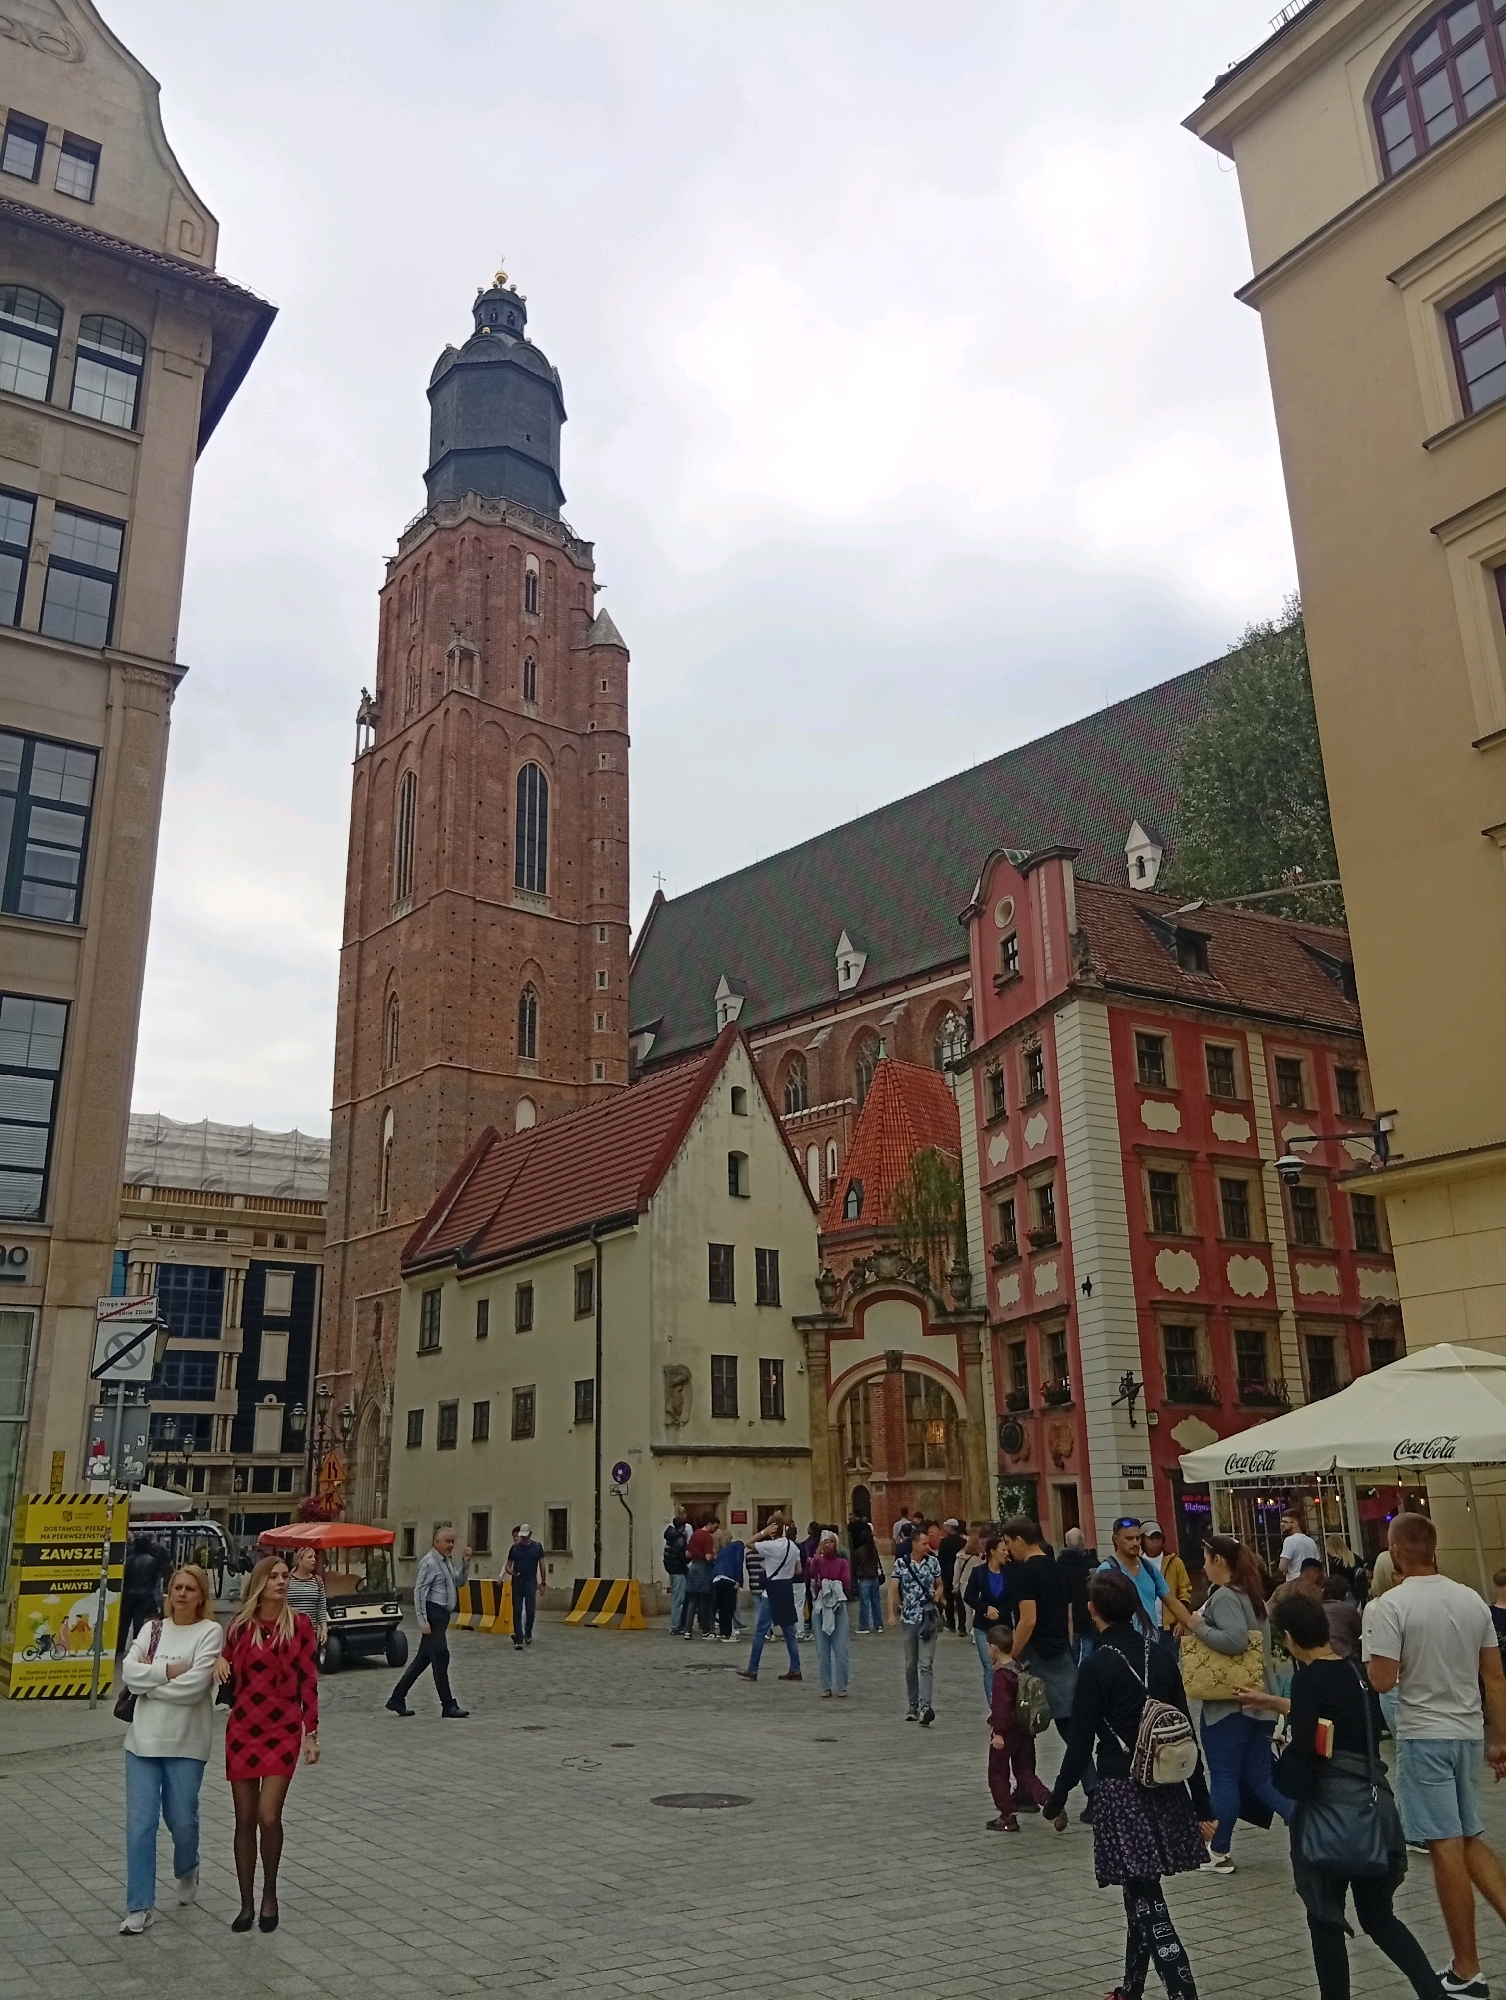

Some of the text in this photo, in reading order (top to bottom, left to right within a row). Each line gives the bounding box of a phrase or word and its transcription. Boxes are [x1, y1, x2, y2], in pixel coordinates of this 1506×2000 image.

[1393, 1436, 1461, 1460] Coca-Cola
[1225, 1450, 1279, 1475] Coca-Cola
[39, 1548, 103, 1561] ZAWSZE
[50, 1582, 93, 1591] ALWAYS!
